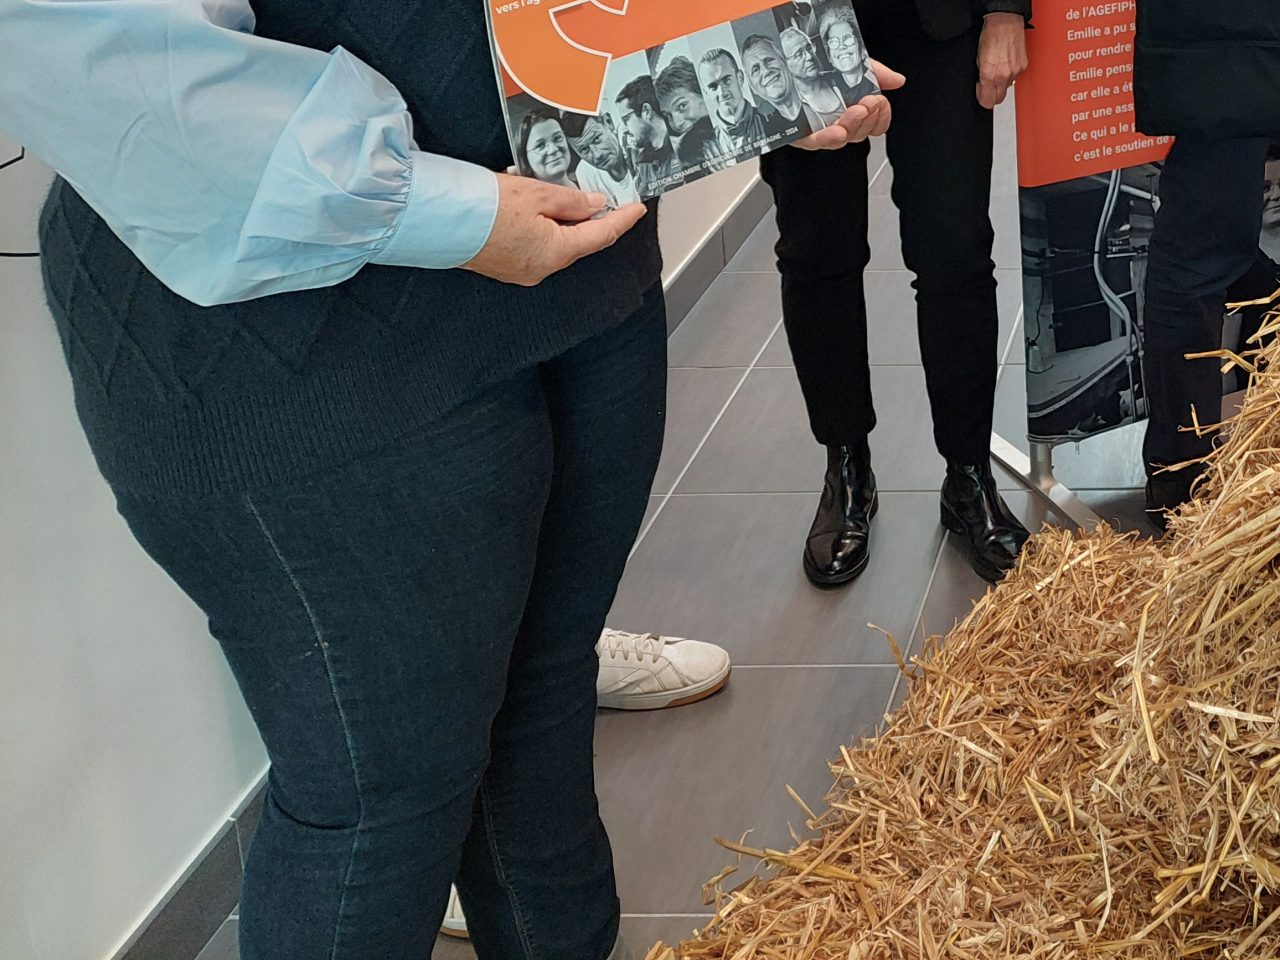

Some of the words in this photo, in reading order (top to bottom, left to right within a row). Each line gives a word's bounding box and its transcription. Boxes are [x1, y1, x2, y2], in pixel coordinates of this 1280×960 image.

[495, 0, 520, 15] vers
[1066, 9, 1080, 21] de
[1067, 27, 1101, 40] Emilie
[1104, 26, 1110, 35] a
[1113, 25, 1126, 38] pu
[1068, 50, 1093, 64] pour
[1096, 42, 1131, 57] rendre
[1069, 66, 1103, 82] Emilie
[1071, 91, 1087, 102] car
[1090, 85, 1110, 98] elle
[1113, 85, 1120, 94] a
[1072, 113, 1089, 124] par
[1093, 107, 1112, 118] une
[1073, 130, 1087, 142] Ce
[1091, 125, 1107, 139] qui
[1110, 125, 1116, 134] a
[1119, 122, 1129, 134] le
[1103, 142, 1112, 156] le
[1115, 136, 1153, 155] soutien
[673, 164, 702, 180] CHAMBRE
[754, 133, 782, 149] BRETAGNE
